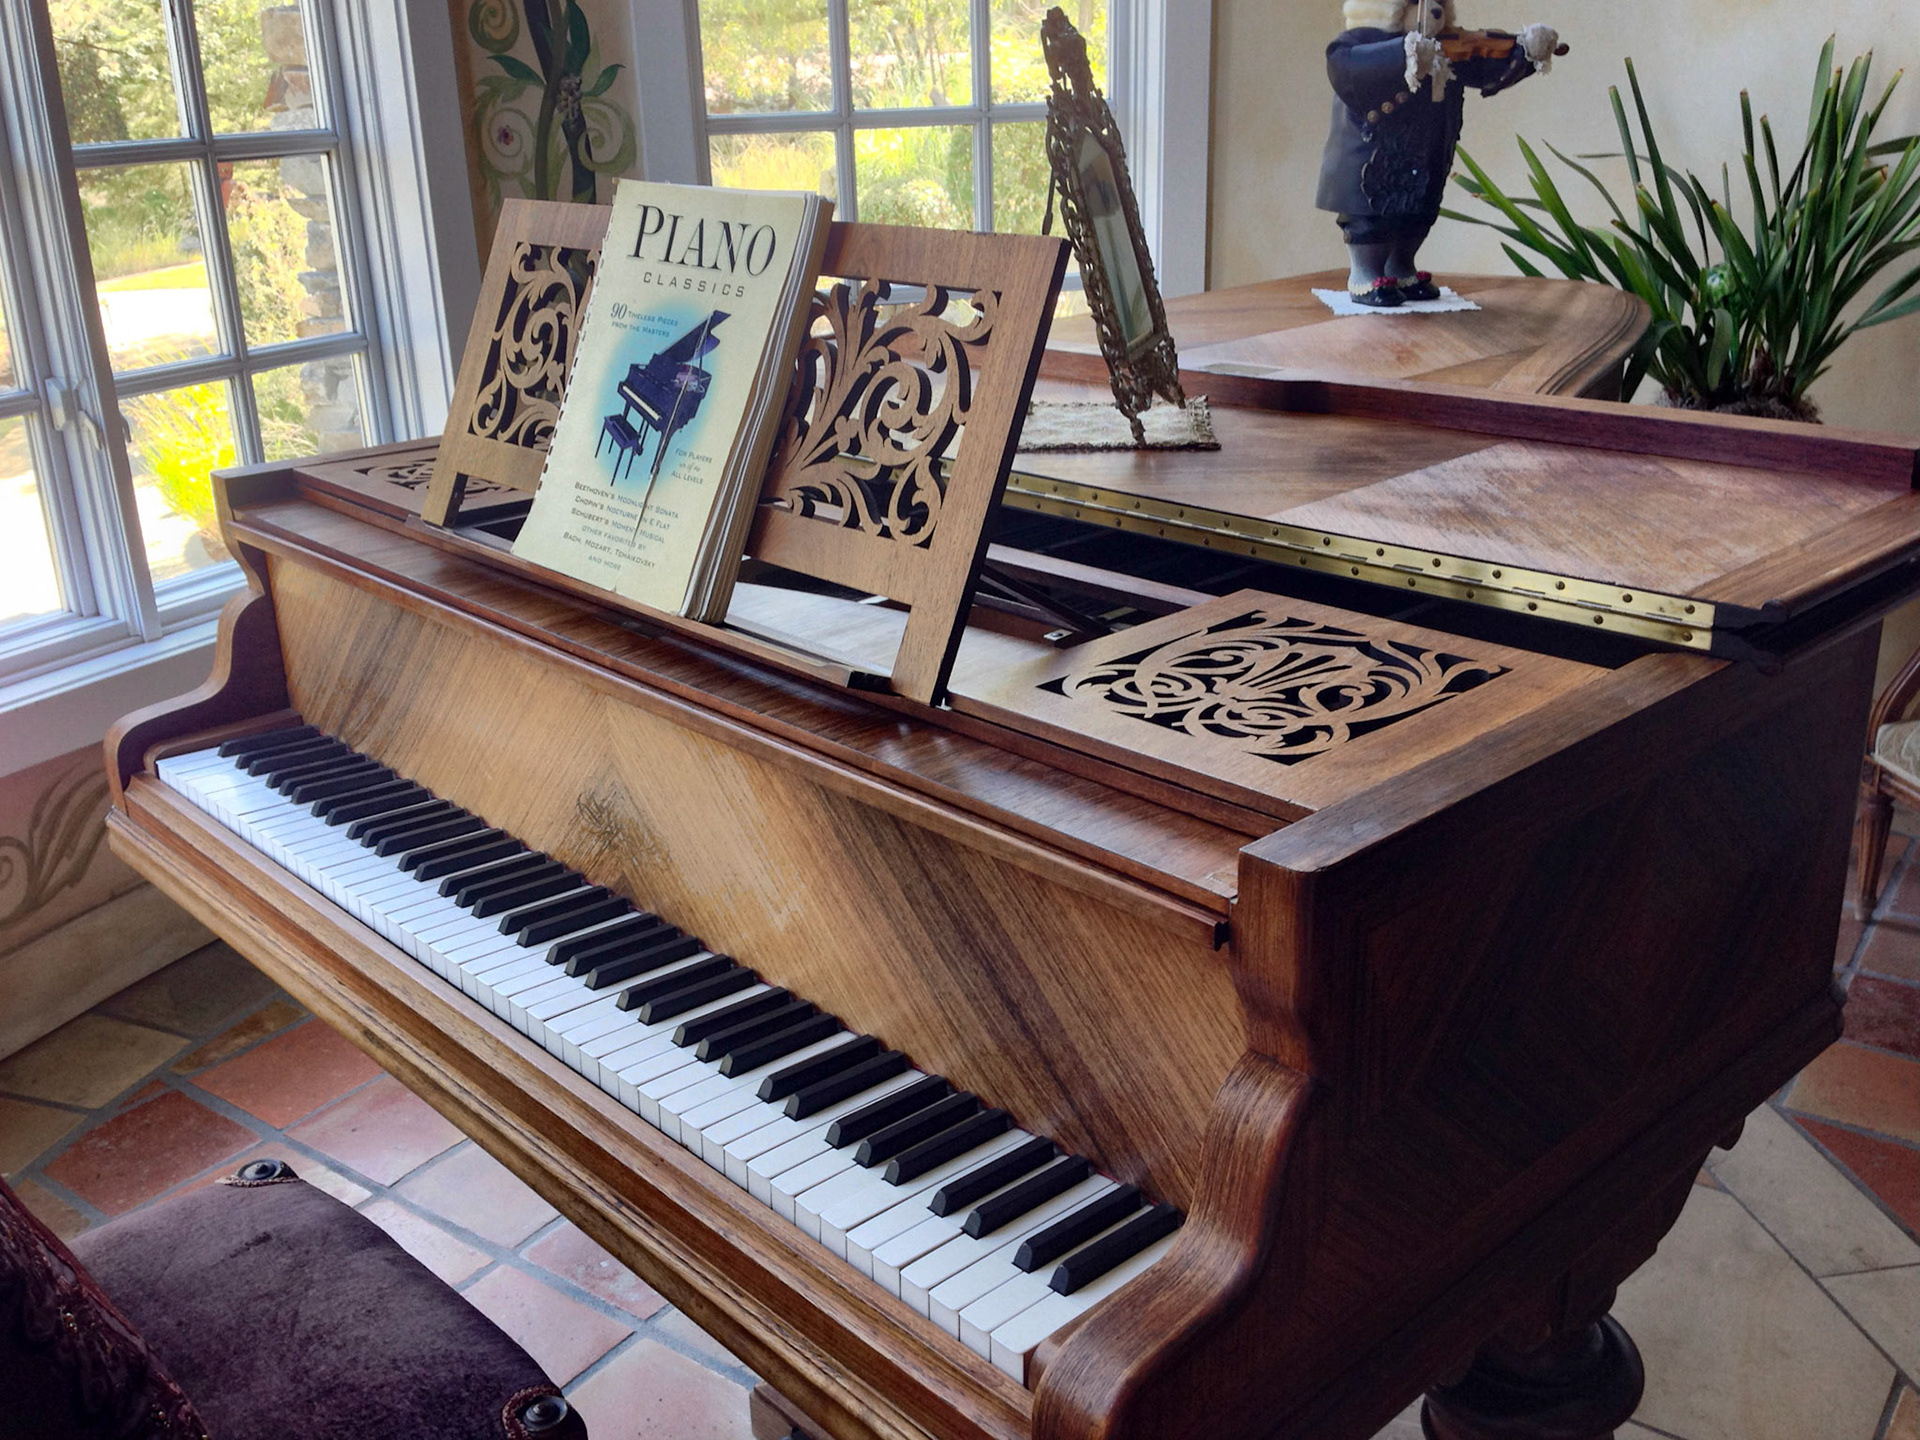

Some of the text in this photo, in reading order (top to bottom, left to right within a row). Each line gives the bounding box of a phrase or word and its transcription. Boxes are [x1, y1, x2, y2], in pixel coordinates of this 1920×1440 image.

[626, 204, 776, 276] PIANO
[643, 272, 745, 298] CLASSICS
[610, 302, 628, 320] 90
[611, 321, 628, 329] FROM
[643, 326, 670, 337] MASTERS
[671, 470, 704, 485] ALL LEVELS
[571, 507, 609, 525] SCHUBERT'S
[606, 505, 638, 521] NOCTURNE
[649, 518, 655, 526] E
[656, 519, 670, 530] FLAT
[655, 505, 679, 519] SONATA
[582, 525, 602, 536] OTHER
[585, 539, 613, 555] MOZART,
[615, 548, 655, 568] TCHAIKOVSKY
[588, 555, 621, 570] AND MORE
